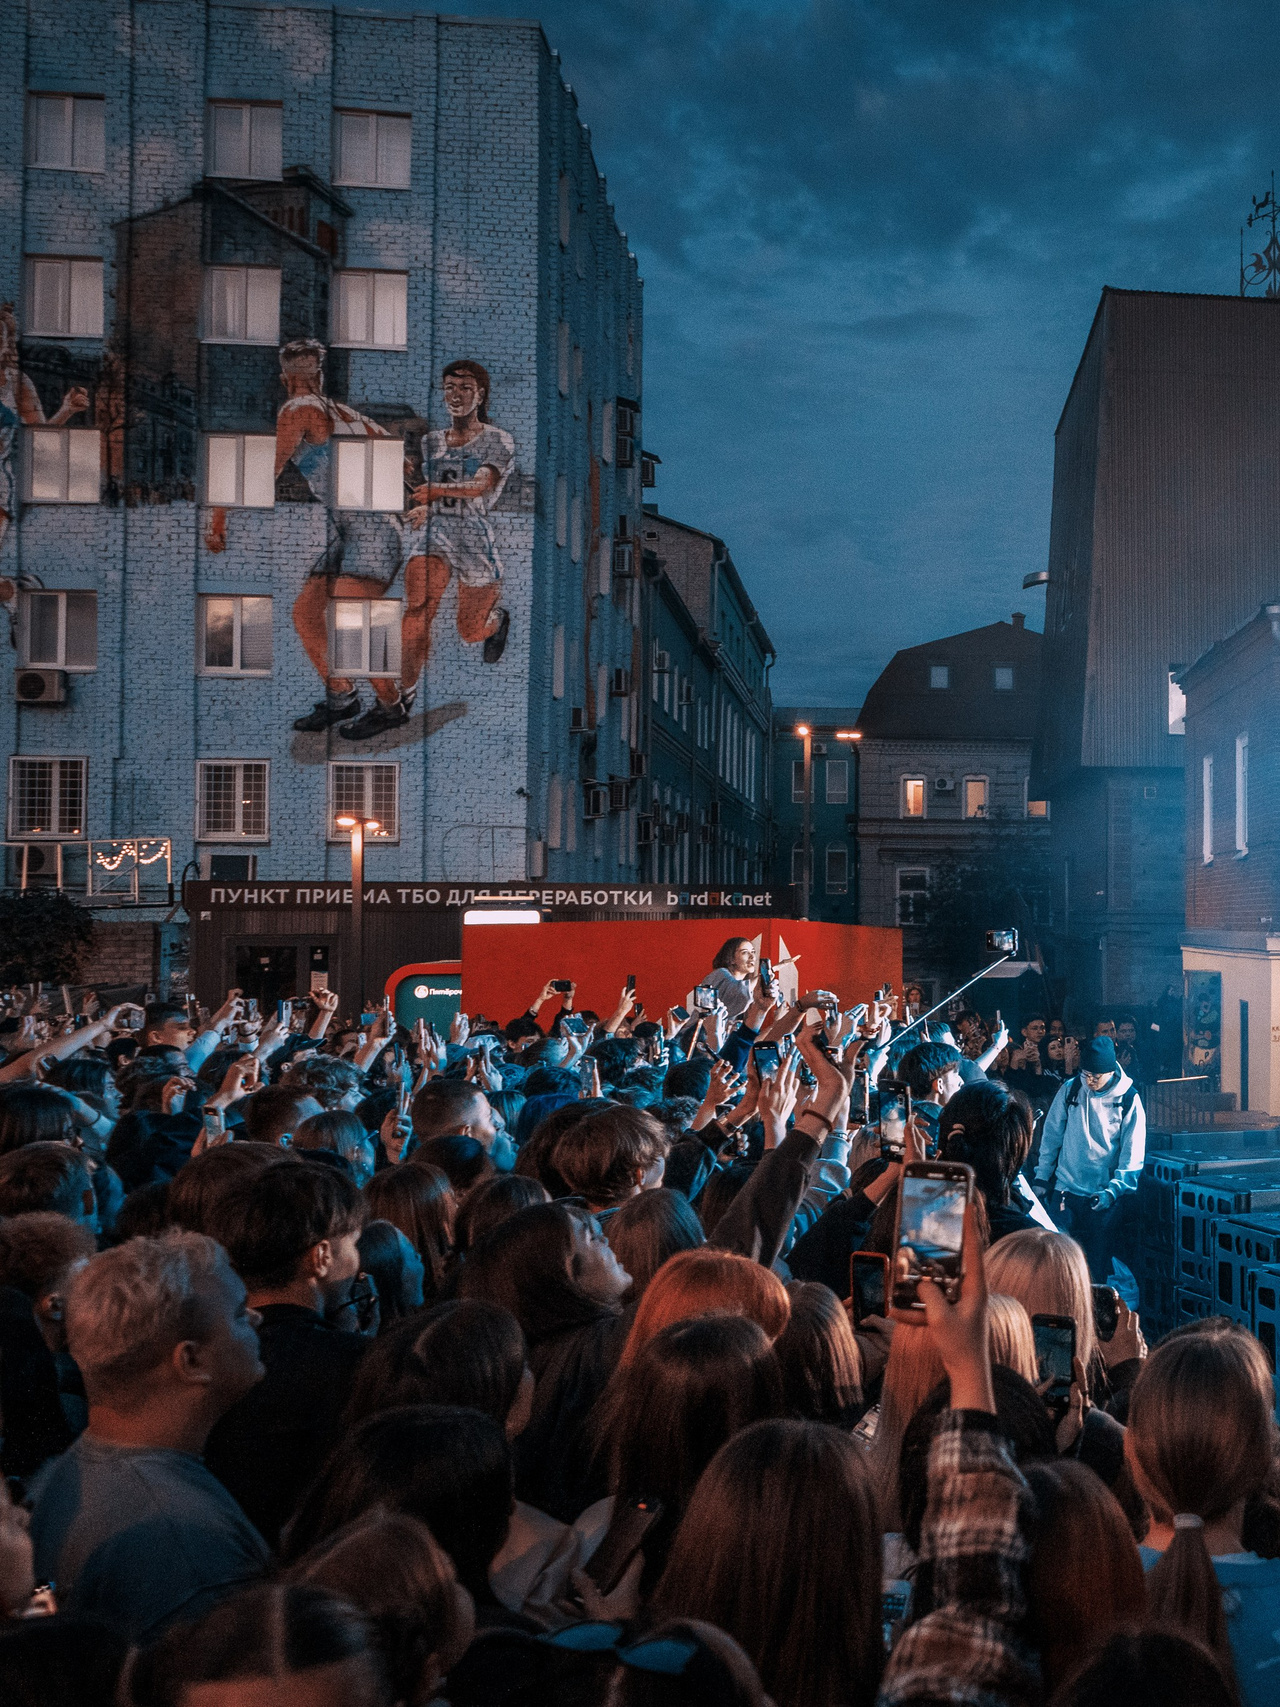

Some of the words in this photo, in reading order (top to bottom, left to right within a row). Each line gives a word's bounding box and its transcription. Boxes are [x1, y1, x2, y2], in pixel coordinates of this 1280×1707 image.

[209, 888, 290, 904] ПУНКТ
[296, 888, 391, 904] ПРИЕМА
[397, 888, 441, 904] ТБО
